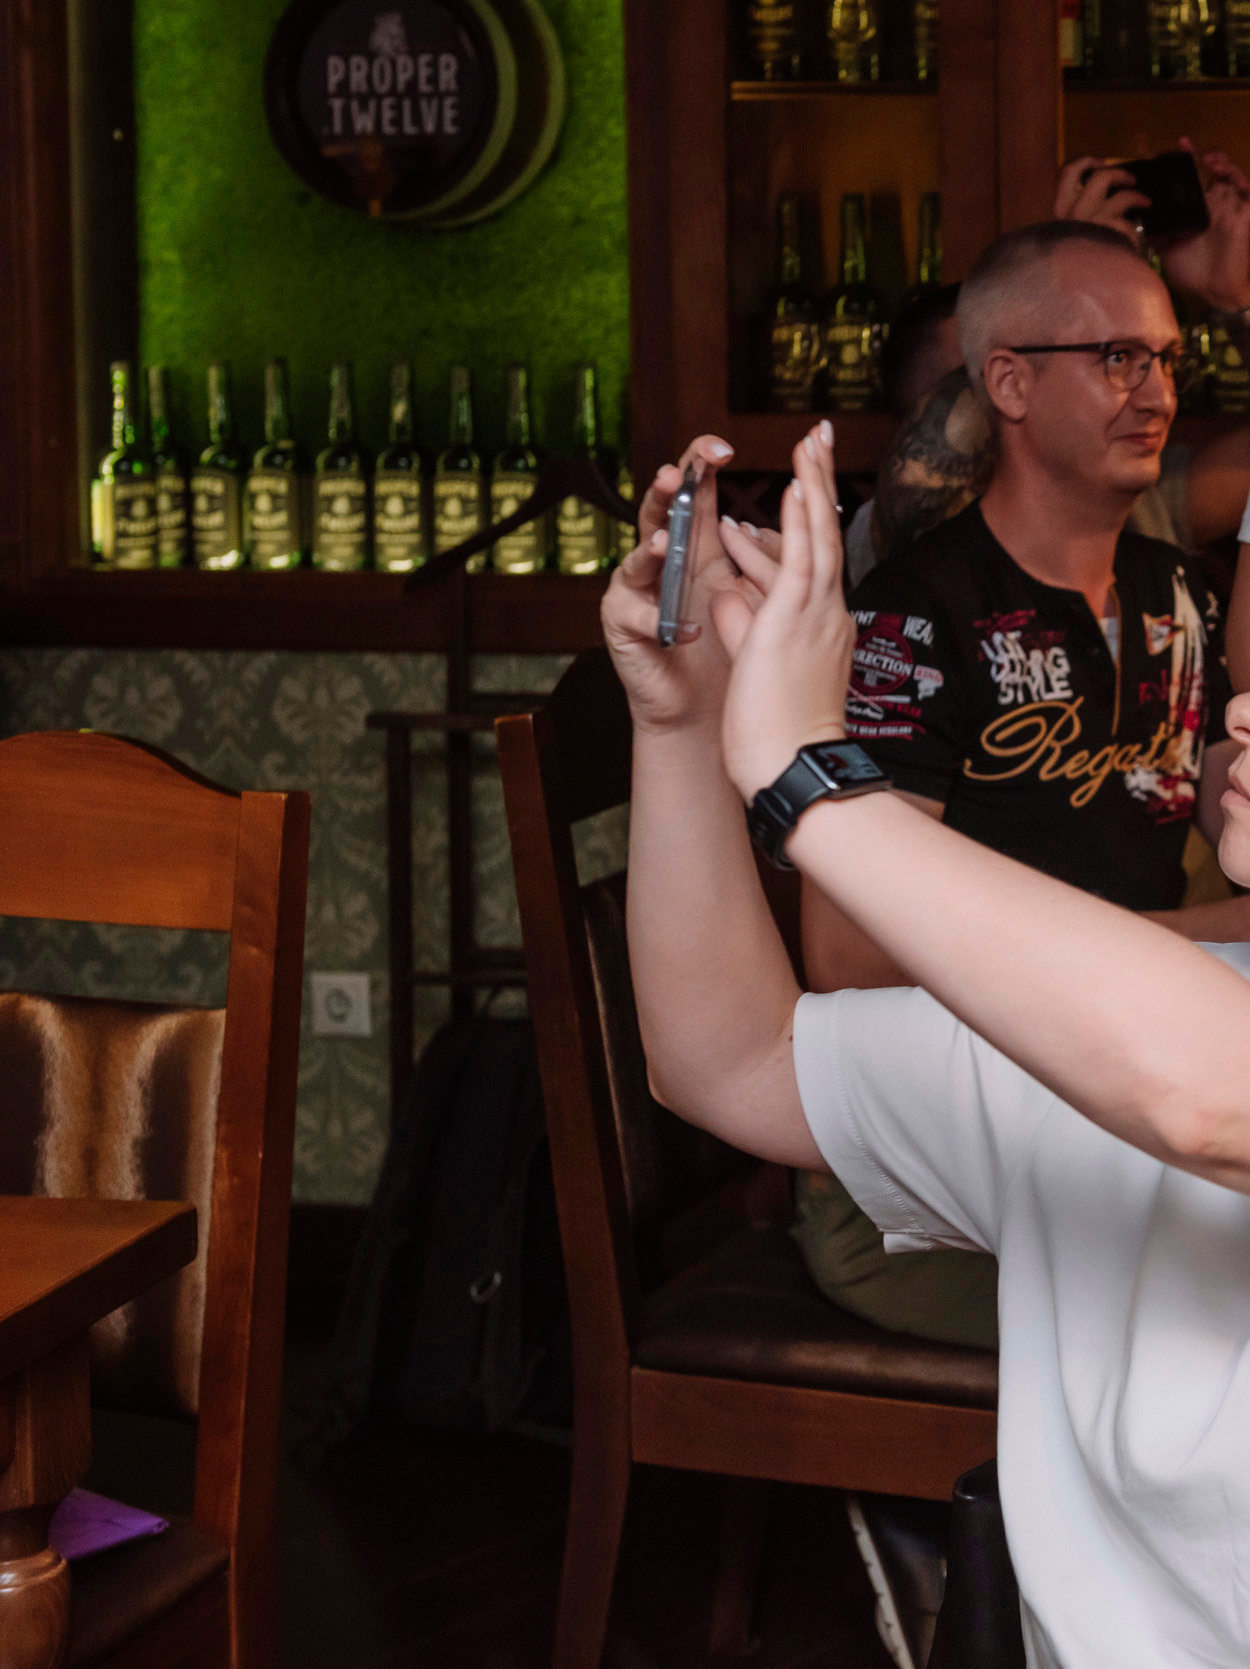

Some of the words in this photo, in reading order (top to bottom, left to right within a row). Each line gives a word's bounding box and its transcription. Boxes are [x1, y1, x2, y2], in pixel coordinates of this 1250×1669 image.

[326, 53, 460, 95] PROPER
[327, 95, 461, 136] TWELVE
[997, 674, 1074, 705] STYLE
